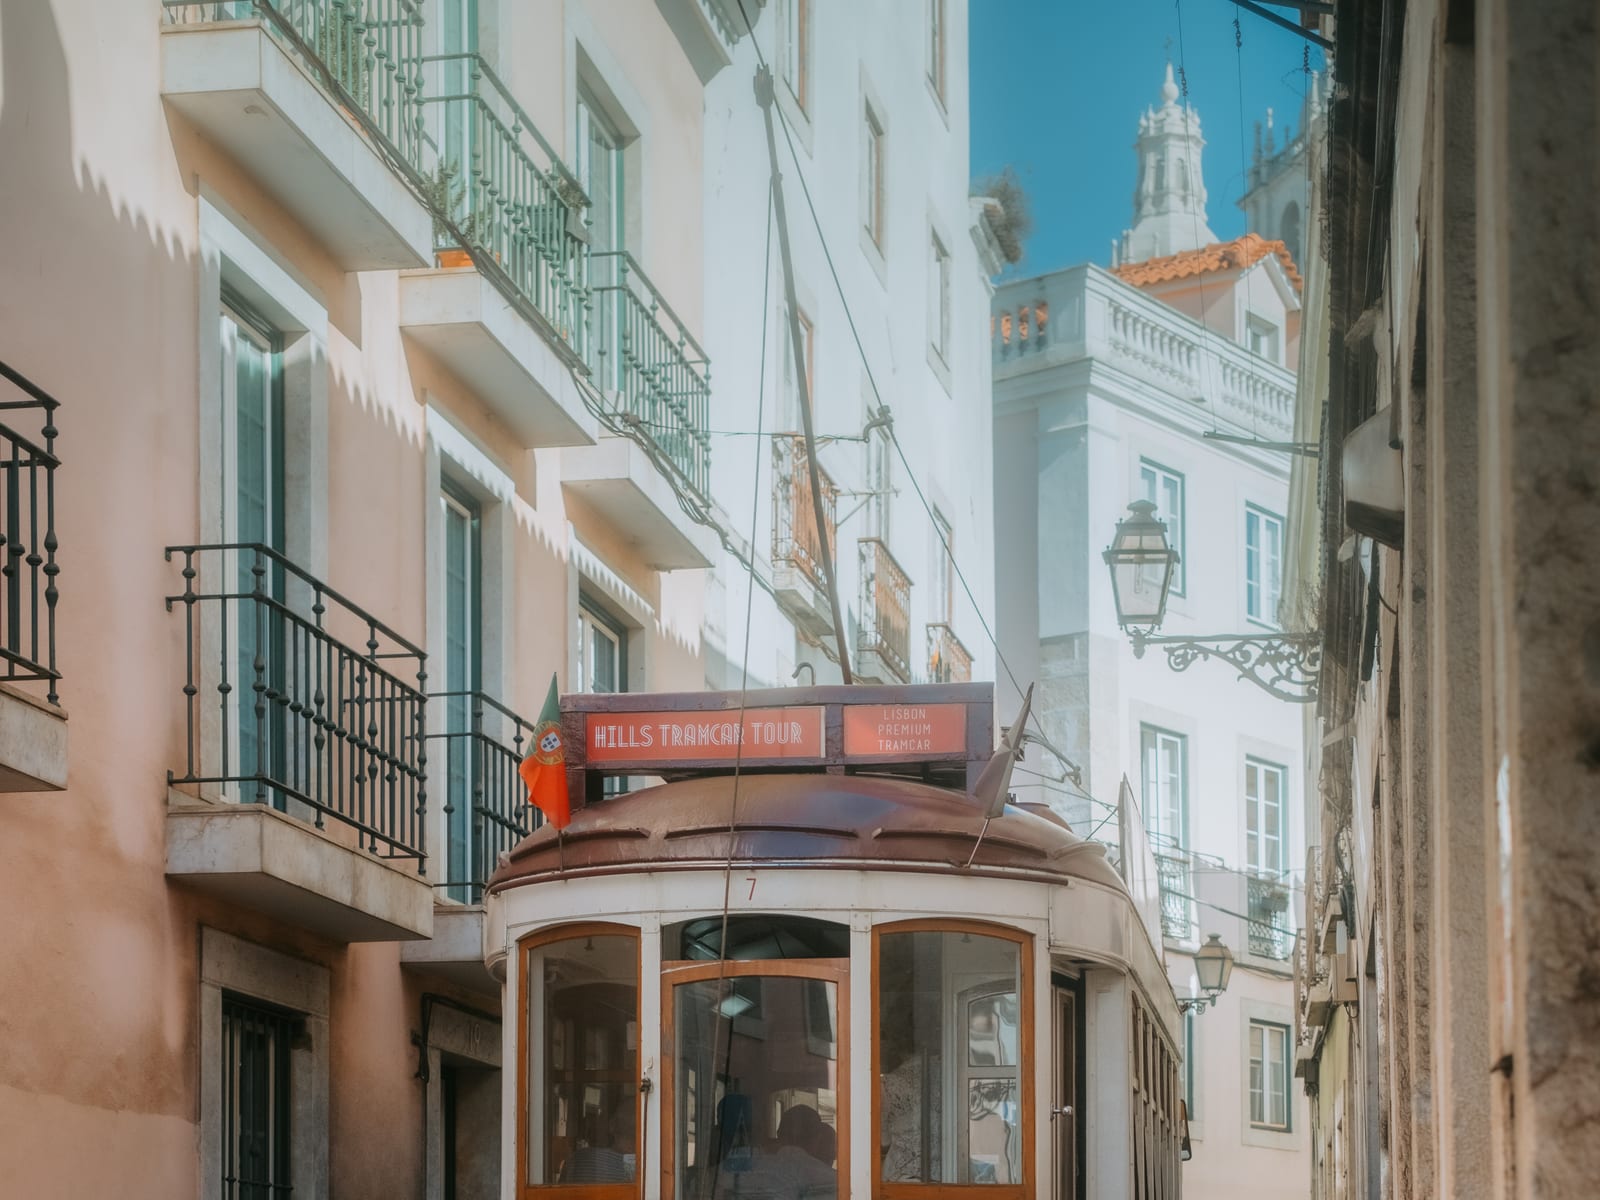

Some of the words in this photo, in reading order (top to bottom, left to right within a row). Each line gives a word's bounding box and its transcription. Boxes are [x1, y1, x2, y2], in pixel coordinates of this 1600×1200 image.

[883, 708, 926, 720] LISBON
[595, 725, 653, 748] HILLS
[659, 723, 745, 746] TRAMCAR
[752, 721, 802, 744] TOUR
[878, 723, 931, 736] PREMIUM
[878, 739, 931, 752] TRAMCAR
[746, 878, 756, 901] 7
